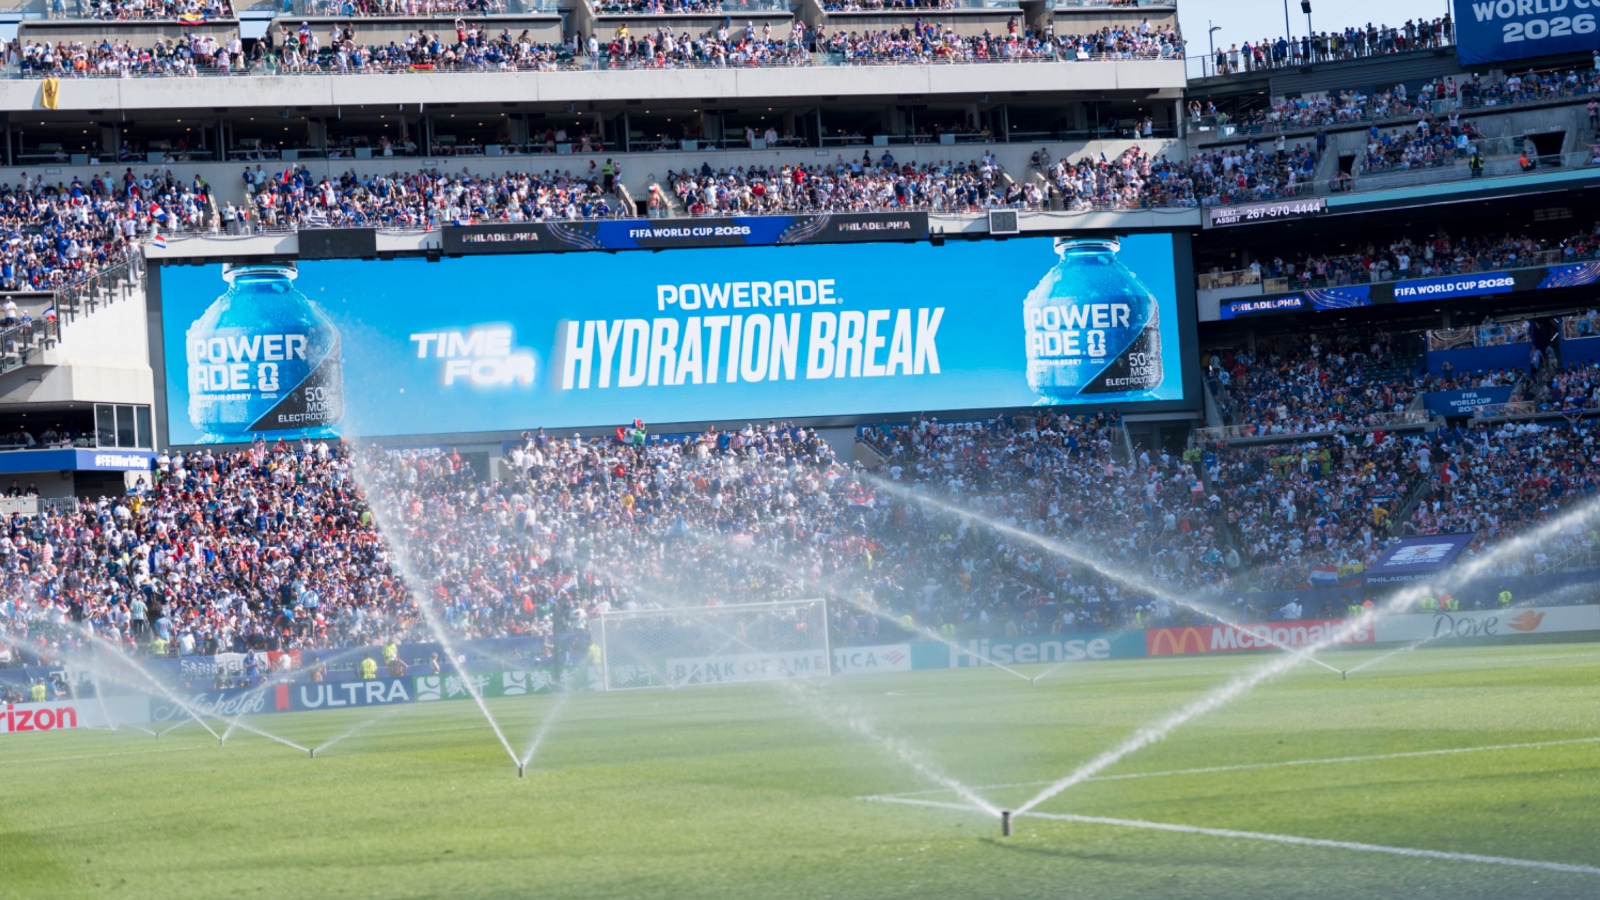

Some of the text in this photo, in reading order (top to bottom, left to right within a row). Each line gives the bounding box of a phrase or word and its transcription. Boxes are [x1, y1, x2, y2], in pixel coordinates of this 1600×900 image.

[1472, 0, 1568, 22] WORLD
[1502, 13, 1596, 43] 2026
[1216, 216, 1241, 224] ASSIST
[1247, 202, 1320, 219] 267-570-4444
[629, 226, 751, 238] FIFA WORLD CUP 2026
[838, 220, 911, 231] PHILADELPHIA
[462, 232, 539, 242] PHILADELPHIA
[1394, 277, 1515, 297] FIFA WORLD CUP 2026
[1231, 298, 1301, 312] PHILADELPHIA
[1030, 303, 1130, 332] POWER
[193, 334, 308, 364] POWER
[410, 328, 512, 358] TIME
[562, 307, 945, 390] HYDRATION BREAK
[444, 355, 535, 385] FOR
[1106, 376, 1157, 386] ELECTROLYTE
[1130, 366, 1154, 377] MORE
[278, 411, 335, 422] ELECTROLYTE
[95, 454, 149, 469] #FIFAWorldCup
[1367, 574, 1440, 583] PHILADELPHIA
[1211, 621, 1370, 649] McDonalds
[1432, 612, 1499, 637] Dove
[949, 638, 1111, 668] Hisense
[674, 651, 879, 681] BANK OF AMERICA
[153, 680, 409, 722] Michelob ULTRA
[0, 704, 77, 732] rizon
